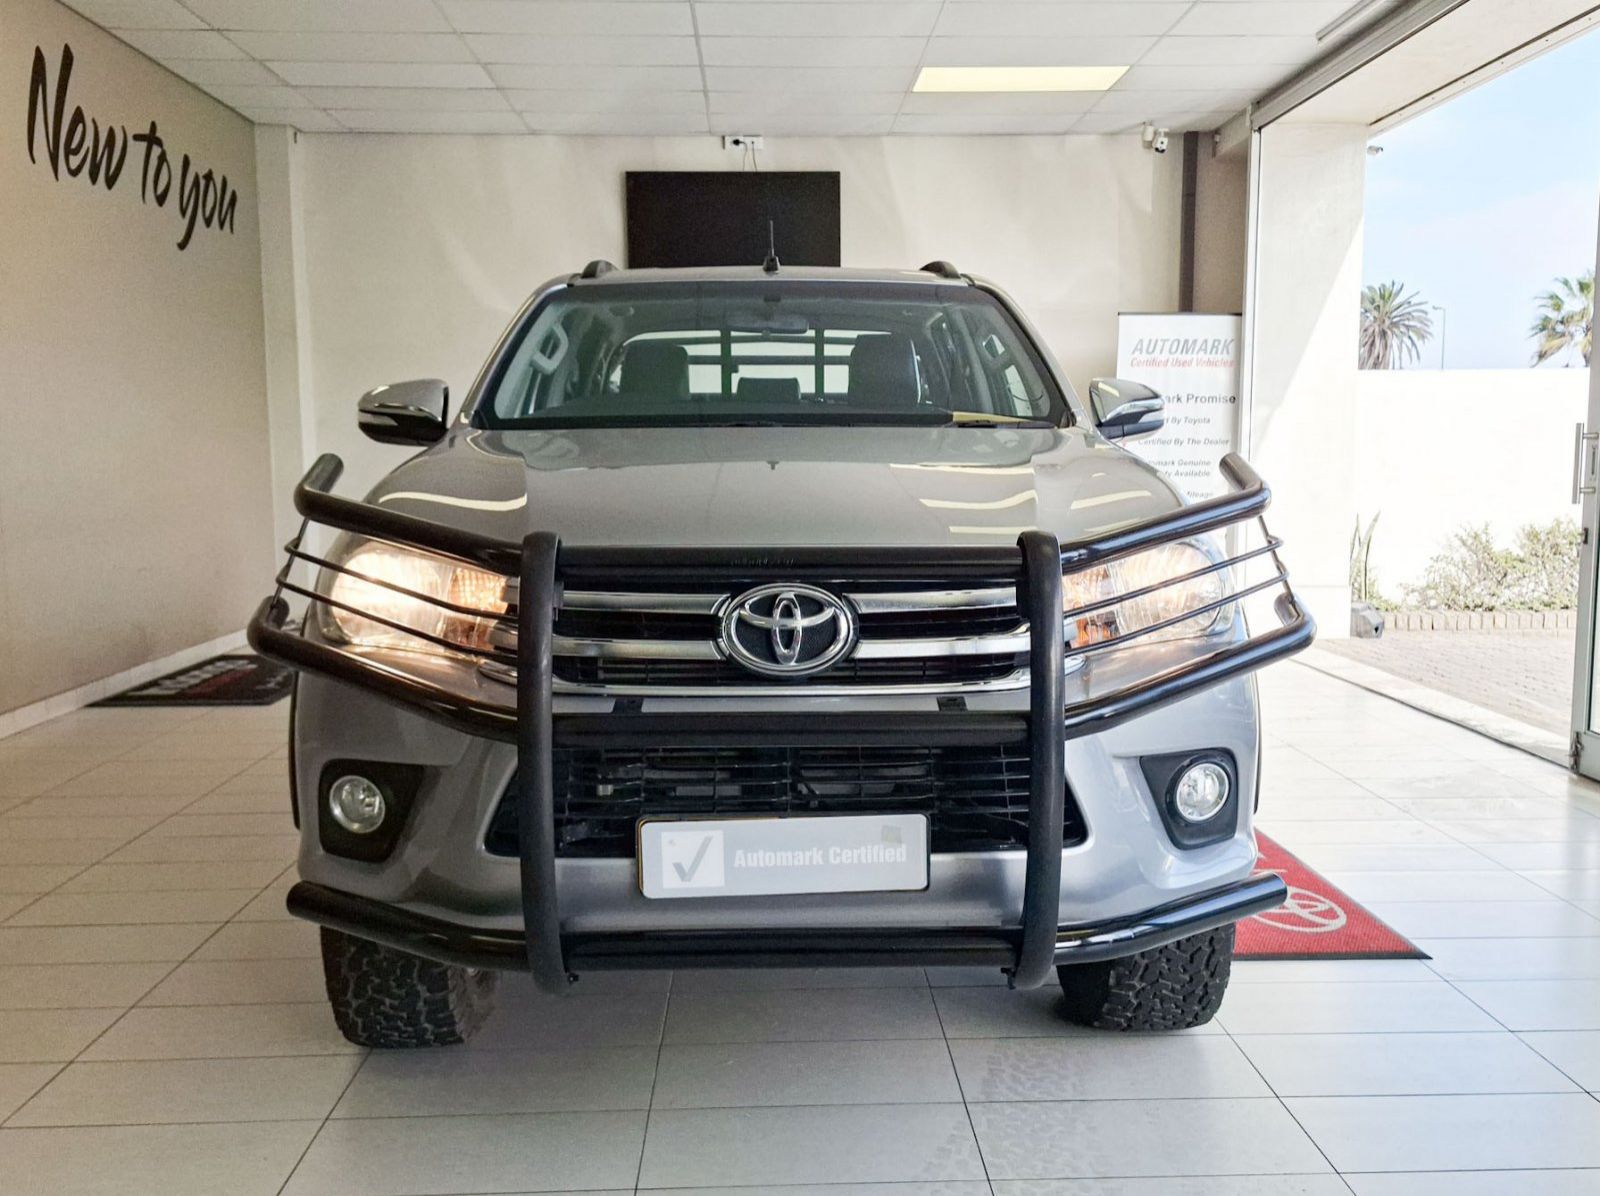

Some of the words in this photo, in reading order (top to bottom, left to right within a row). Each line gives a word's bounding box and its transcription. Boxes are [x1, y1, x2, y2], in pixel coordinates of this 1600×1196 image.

[27, 43, 128, 190] New
[132, 120, 172, 207] to
[176, 153, 238, 251] you
[1131, 338, 1234, 355] AUTOMARK
[1130, 358, 1168, 369] Certified
[1170, 358, 1193, 369] Used
[1195, 358, 1236, 369] Vehicles
[1186, 393, 1236, 404] Promise
[1171, 416, 1182, 425] By
[1184, 416, 1211, 426] Toyota
[1138, 438, 1172, 446] Certified
[1173, 438, 1184, 446] By
[1187, 437, 1201, 446] The
[1203, 438, 1229, 446] Dealer
[1177, 459, 1211, 467] Genuine
[733, 847, 824, 868] Automark
[828, 843, 907, 865] Certified
